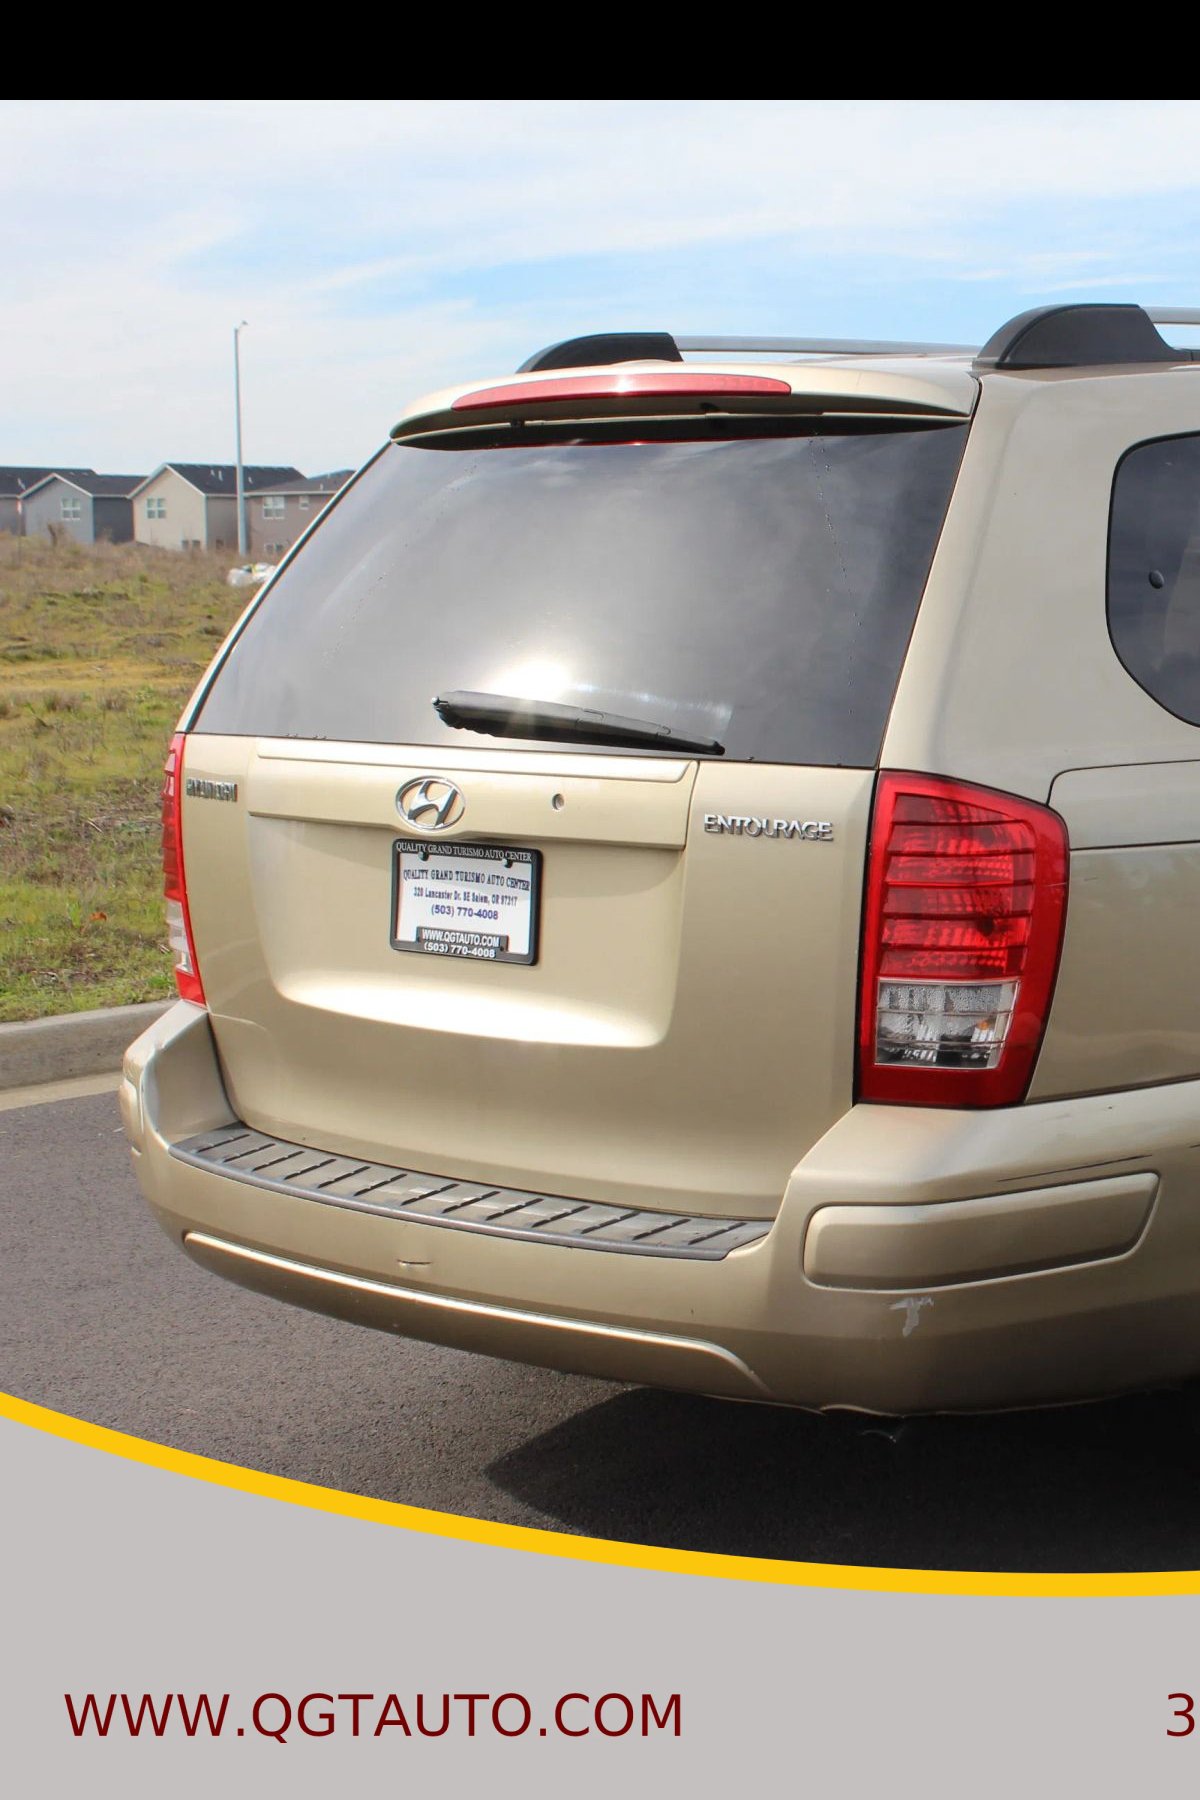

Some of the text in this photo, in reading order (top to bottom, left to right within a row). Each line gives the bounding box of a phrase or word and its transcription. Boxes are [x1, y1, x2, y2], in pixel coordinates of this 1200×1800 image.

[704, 813, 834, 841] ENTOURAGE
[396, 842, 532, 861] QUALITY GRAND TURISMO AUTO CENTER
[403, 869, 530, 891] QUALITY GRAND TURISMO AUTO CENTER
[425, 888, 453, 900] Lancaster
[431, 903, 499, 920] (503) 770-4008
[422, 929, 499, 947] WWW.QGTAUTO.COM
[424, 943, 496, 958] (503) 770-4008
